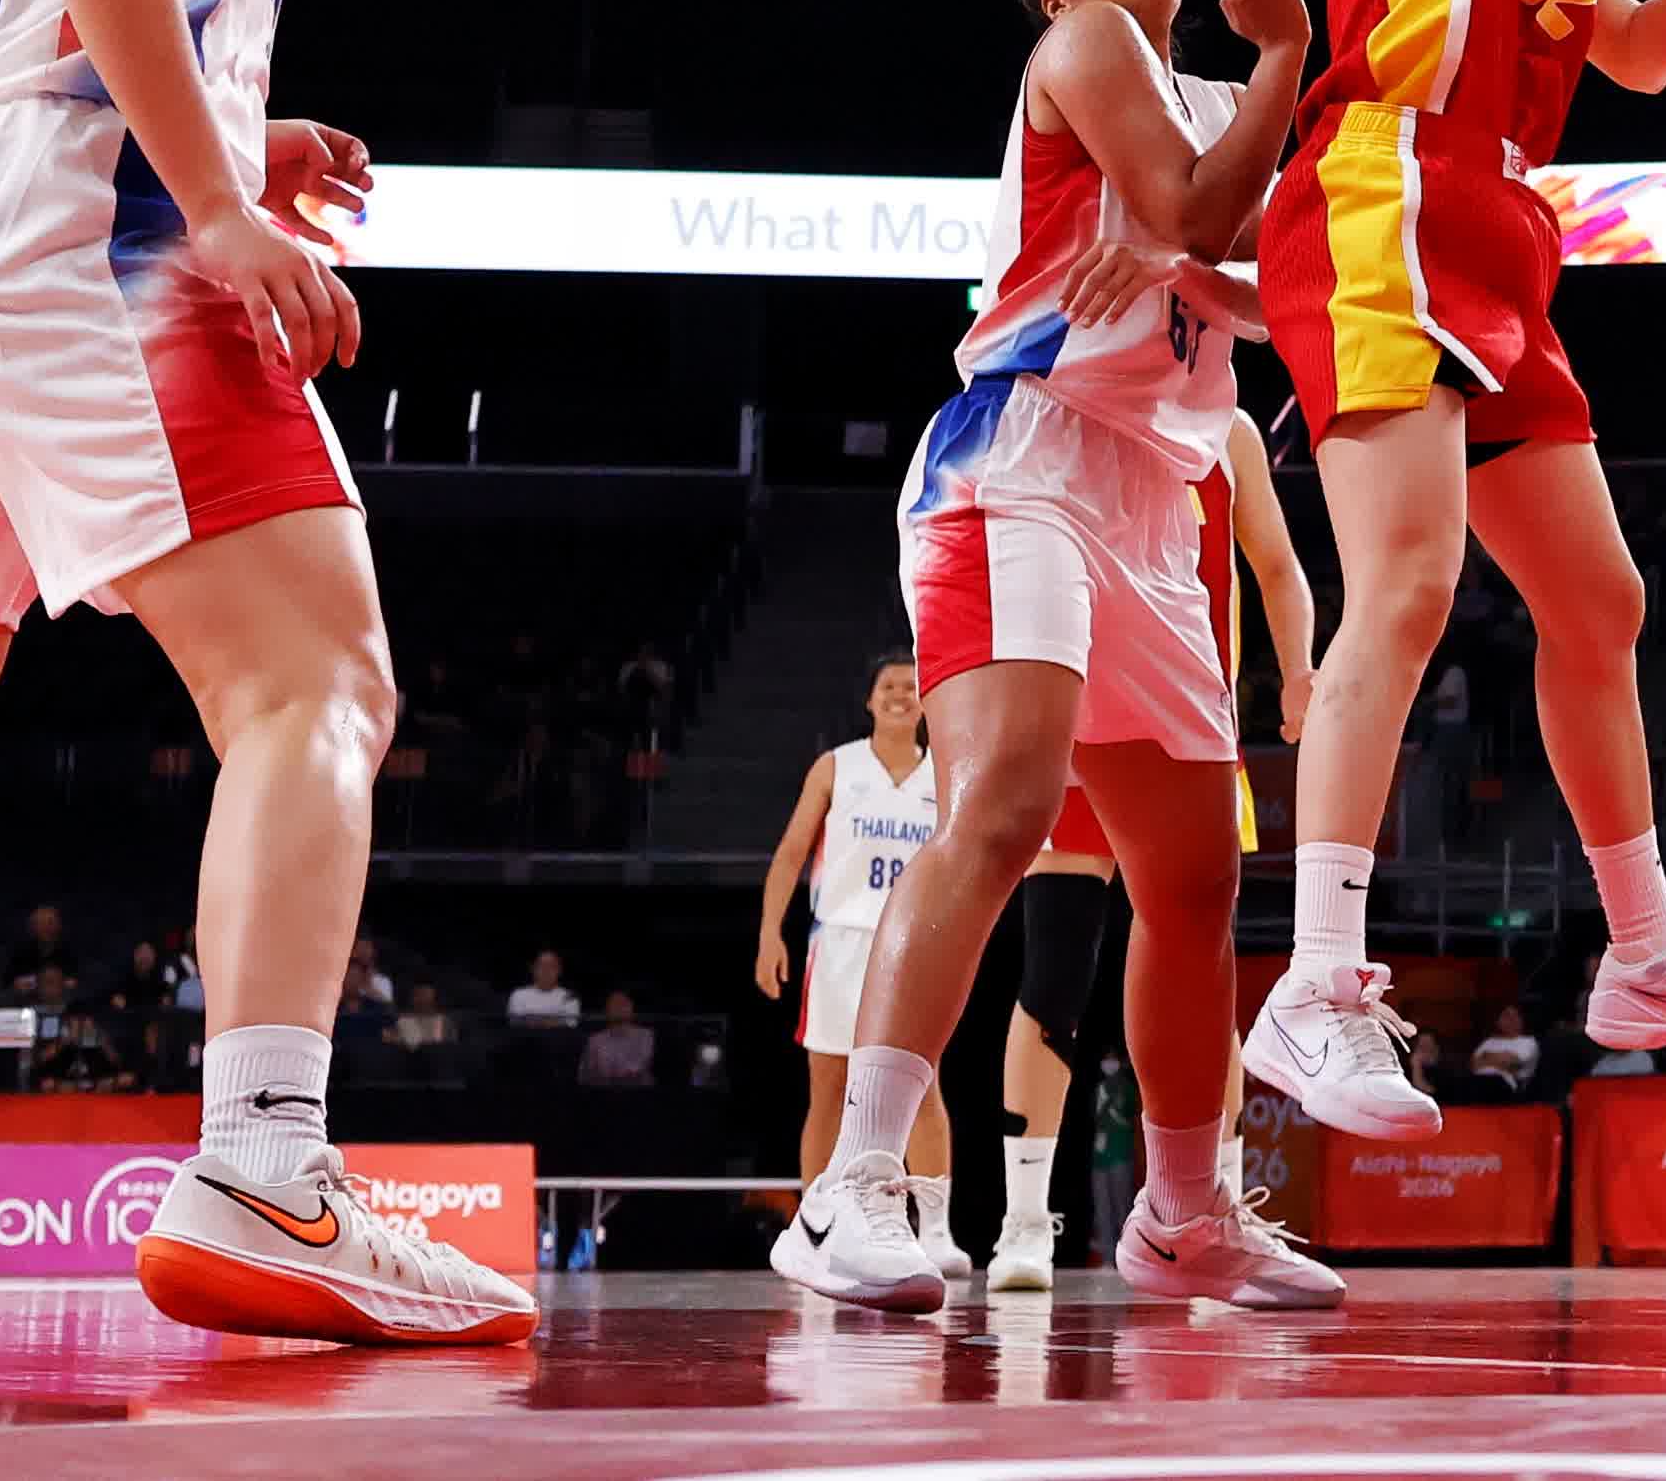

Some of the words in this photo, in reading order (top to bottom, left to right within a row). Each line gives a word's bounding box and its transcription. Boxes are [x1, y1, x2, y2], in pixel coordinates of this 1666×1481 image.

[669, 197, 844, 255] What
[869, 203, 999, 258] Mov
[851, 817, 935, 846] THAILAND
[1244, 1147, 1291, 1187] 26
[354, 1179, 504, 1219] -Nagoya
